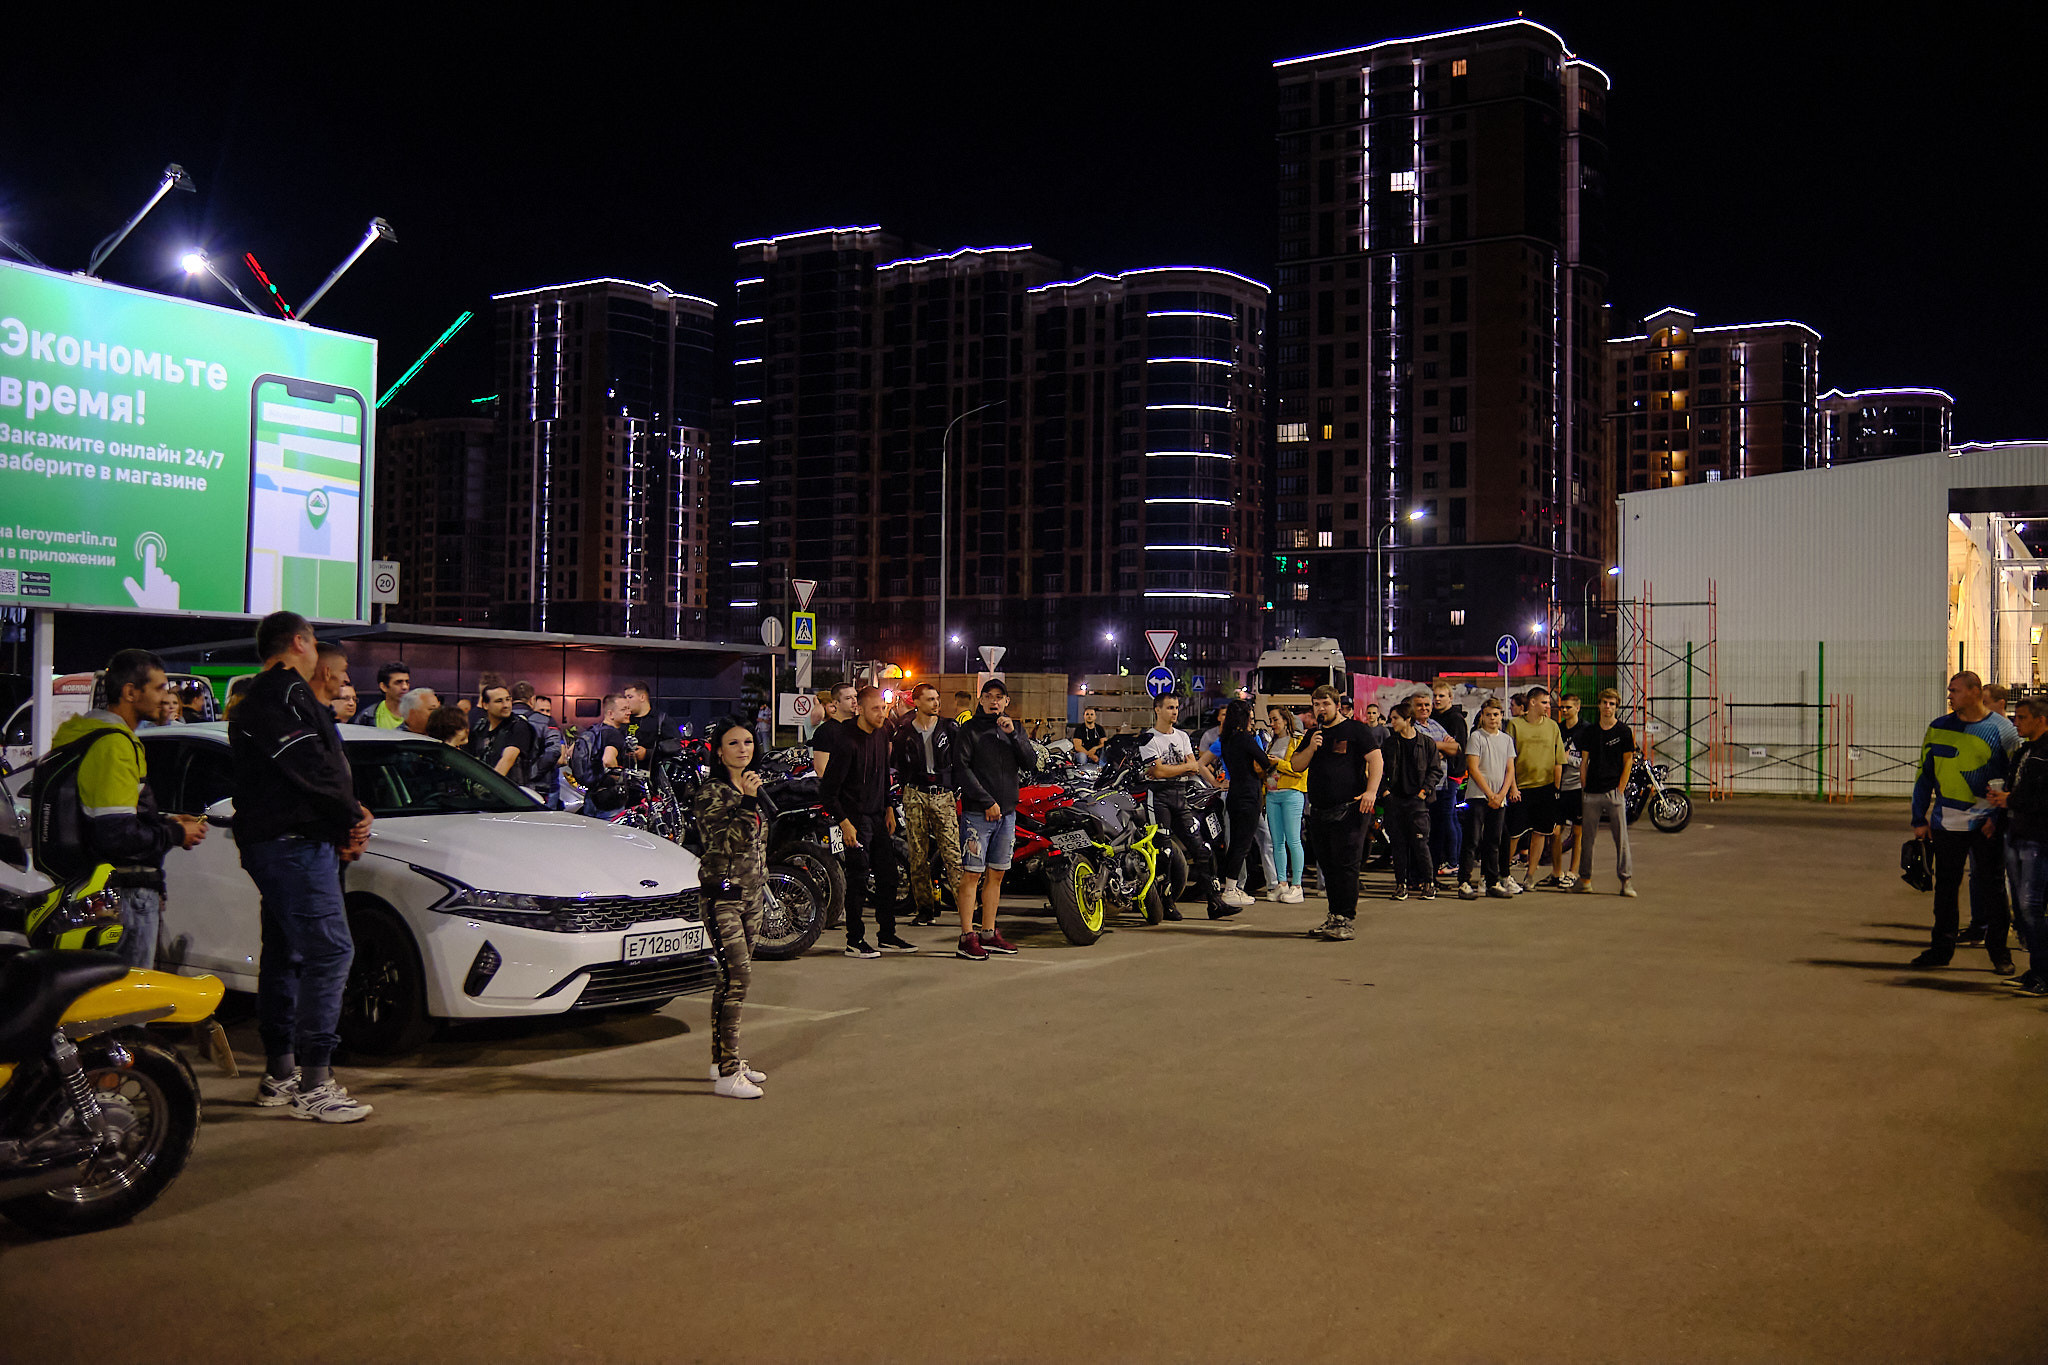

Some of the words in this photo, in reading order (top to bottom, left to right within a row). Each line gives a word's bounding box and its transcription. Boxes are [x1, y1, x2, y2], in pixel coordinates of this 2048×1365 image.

[0, 317, 228, 391] Экономьте
[0, 376, 146, 425] время!
[0, 423, 105, 454] Закажите
[109, 443, 181, 464] онлайн
[185, 448, 224, 470] 24/7
[0, 452, 96, 478] заберите
[100, 465, 111, 480] в
[116, 467, 207, 491] магазине
[16, 525, 117, 547] leroymerlin.ru
[7, 547, 16, 558] в
[20, 548, 116, 567] приложении
[380, 579, 391, 588] 20
[62, 684, 92, 692] МОБИЛЬН
[682, 930, 700, 945] 193
